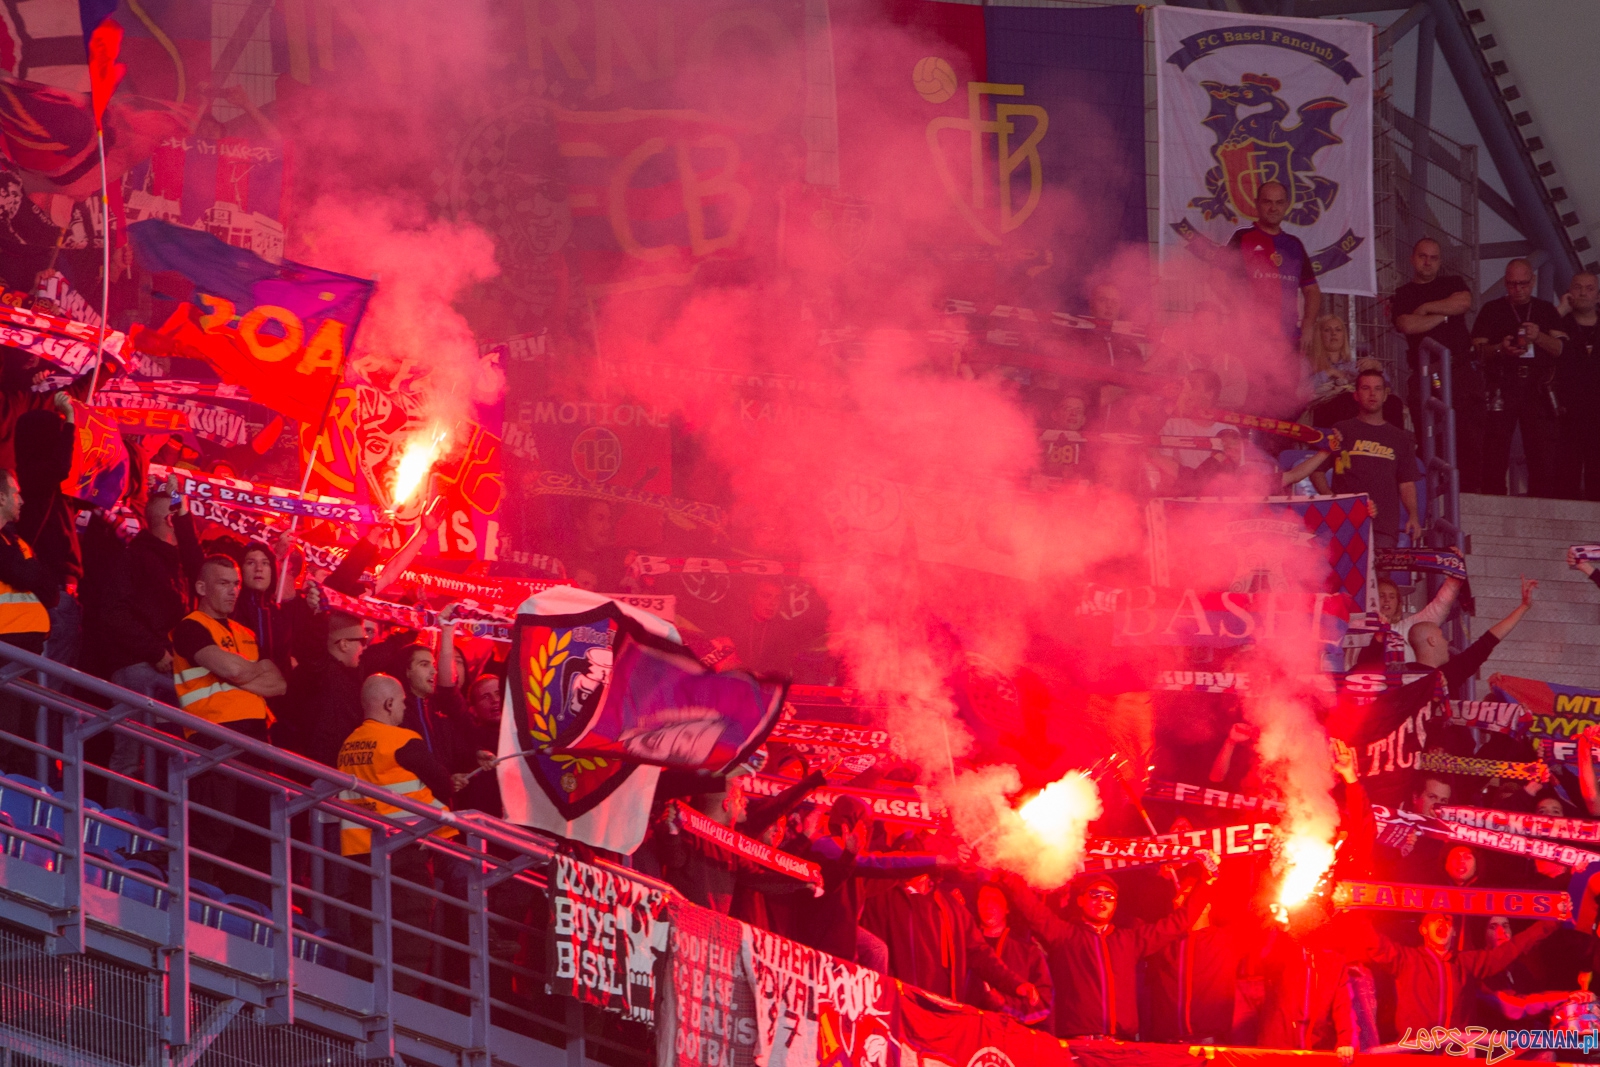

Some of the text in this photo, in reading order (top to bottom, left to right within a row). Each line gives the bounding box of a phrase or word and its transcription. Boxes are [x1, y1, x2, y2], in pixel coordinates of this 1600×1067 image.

[1196, 30, 1335, 62] FC Basel Fanclub
[1351, 885, 1554, 914] FANATICS
[554, 896, 617, 951] BOYS
